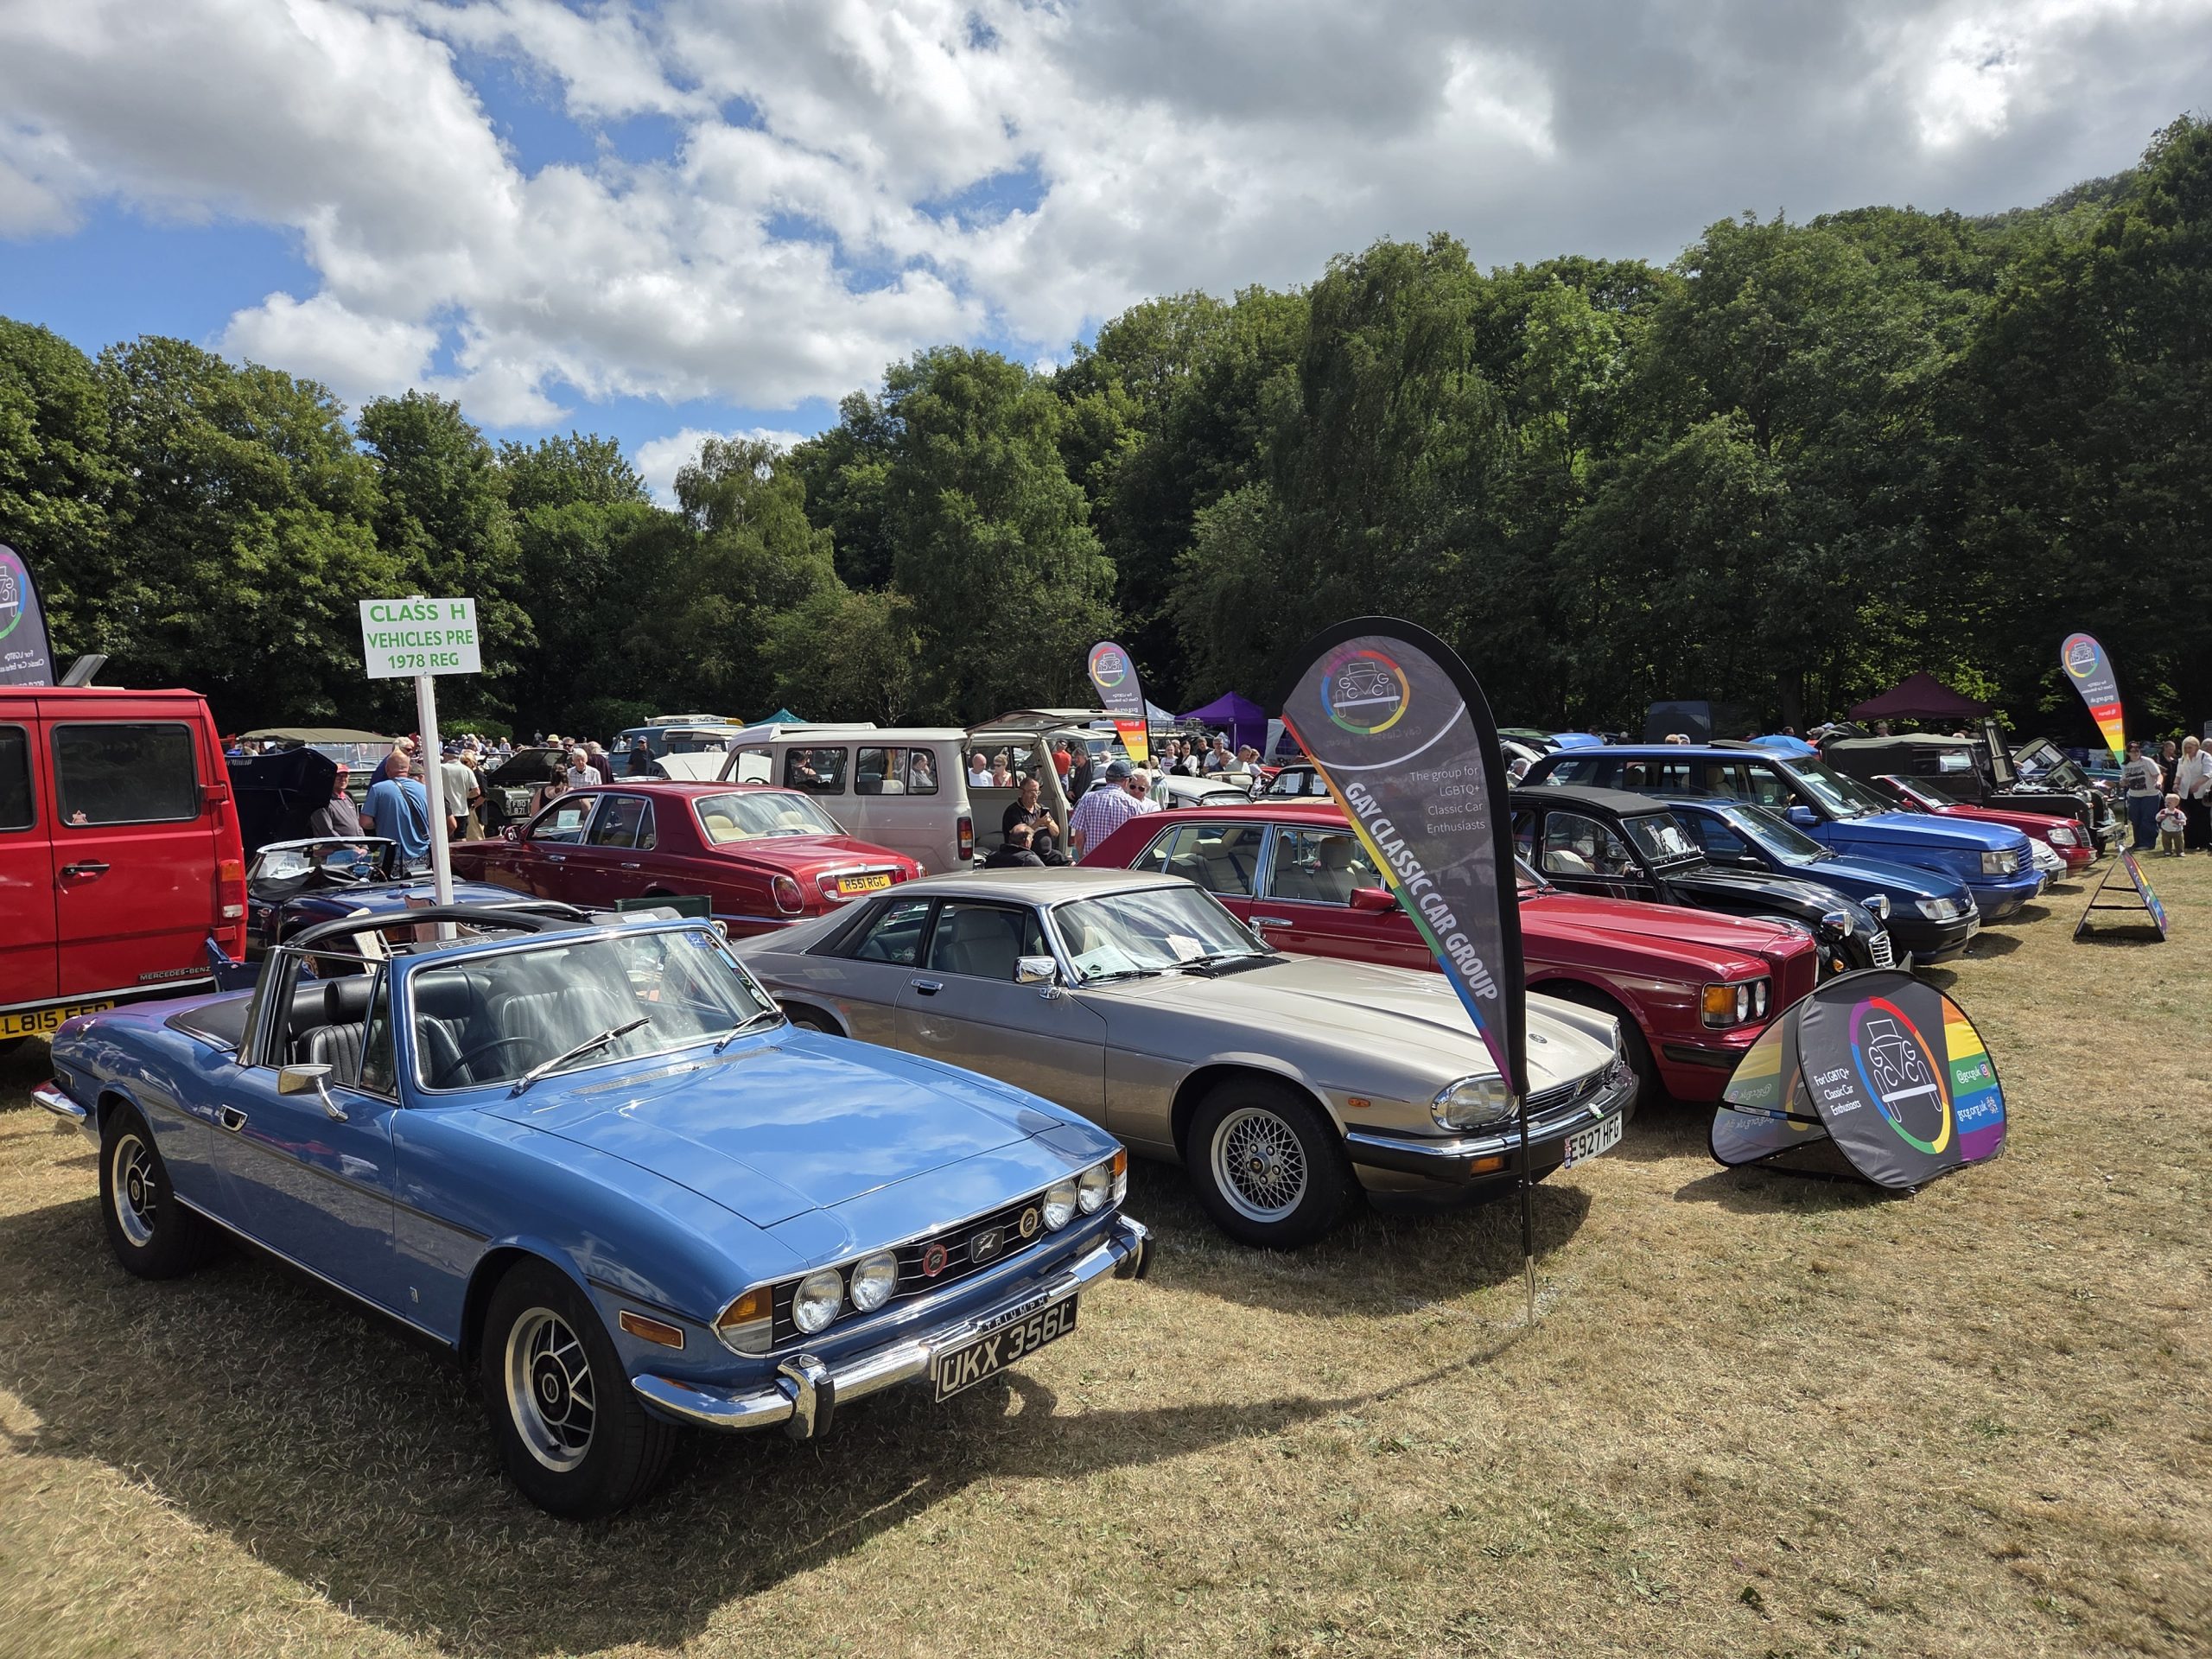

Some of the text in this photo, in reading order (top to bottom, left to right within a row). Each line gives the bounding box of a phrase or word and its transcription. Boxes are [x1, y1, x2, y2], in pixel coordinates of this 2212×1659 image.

[370, 603, 467, 622] CLASS H
[367, 629, 474, 649] VEHICLES PRE
[388, 652, 459, 669] 1978 REG
[1409, 765, 1478, 783] The group for
[1440, 784, 1480, 797] LGBTQ+
[1427, 802, 1484, 816] Classic Car
[1427, 819, 1486, 834] Enthusiasts
[844, 876, 886, 890] R551 RGC
[1345, 782, 1498, 1001] GAY CLASSIC CAR GROUP
[139, 966, 211, 981] MERCEDES-BENZ
[3, 1011, 59, 1035] L815
[1814, 1068, 1849, 1086] For LGBTQ+
[1824, 1084, 1853, 1100] Classic Car
[1830, 1100, 1862, 1116] Enthusiasts
[1570, 1128, 1601, 1162] E927
[985, 1297, 1046, 1331] TRIUMPH
[942, 1303, 1074, 1393] UKX 356L
